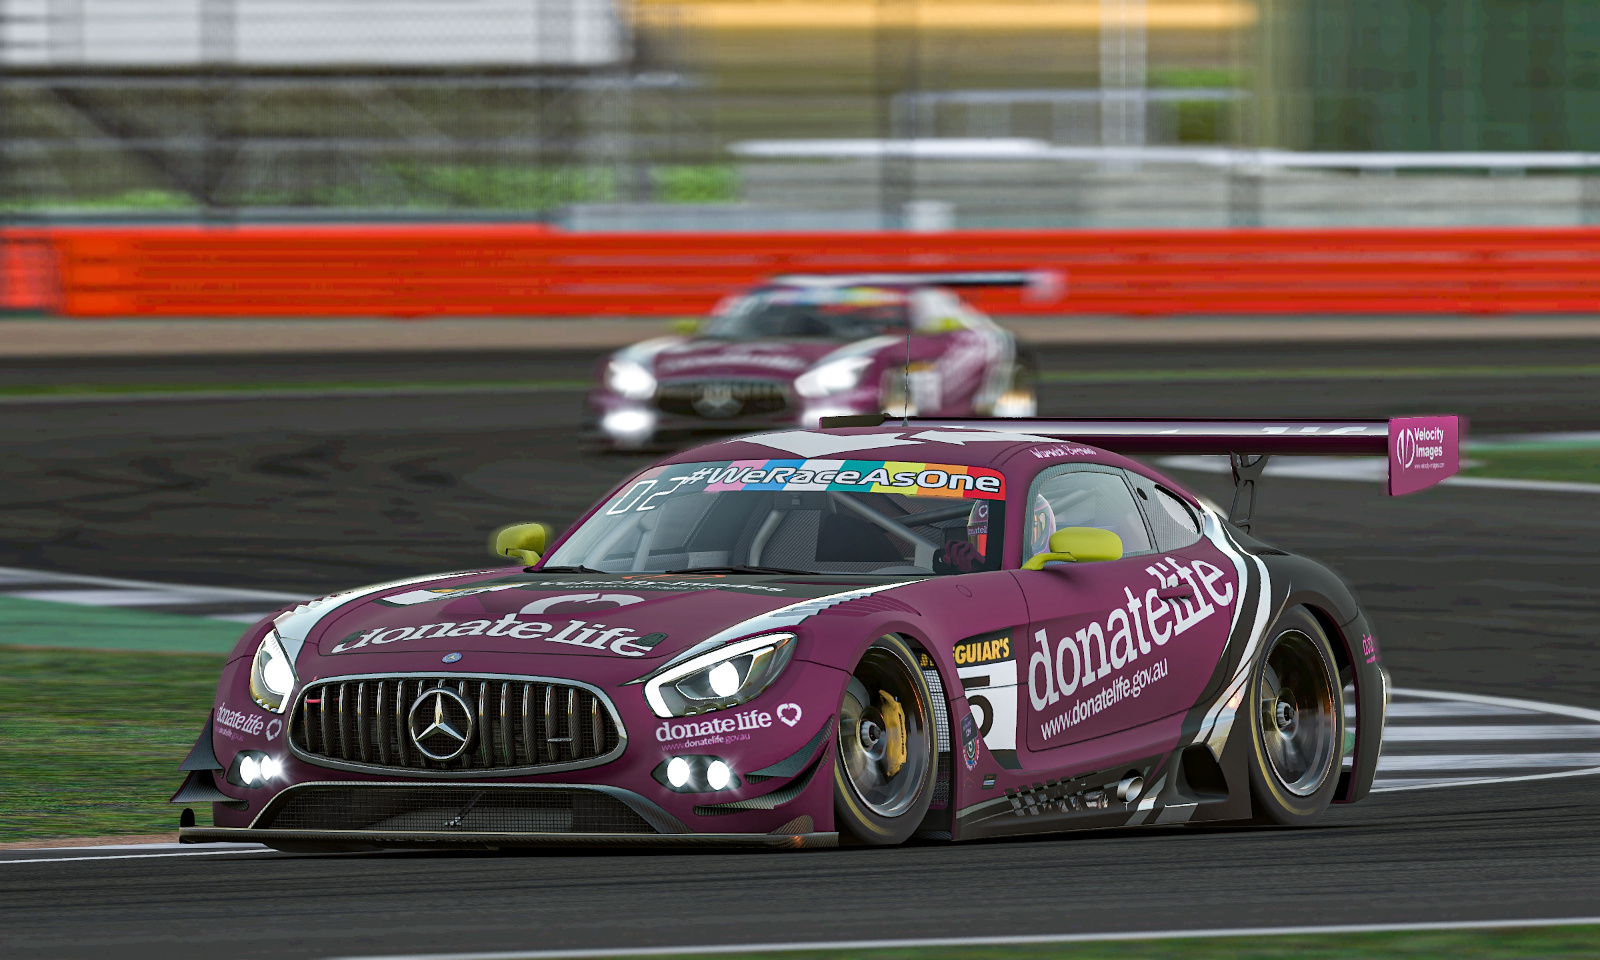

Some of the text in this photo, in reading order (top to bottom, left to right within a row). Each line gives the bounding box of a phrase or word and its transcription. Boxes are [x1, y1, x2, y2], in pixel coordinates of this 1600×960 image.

[1414, 426, 1444, 444] Velocity
[1415, 443, 1443, 461] Images
[682, 467, 1001, 493] #WeRaceAsOne
[1040, 657, 1169, 741] www.donatelife.gov.au
